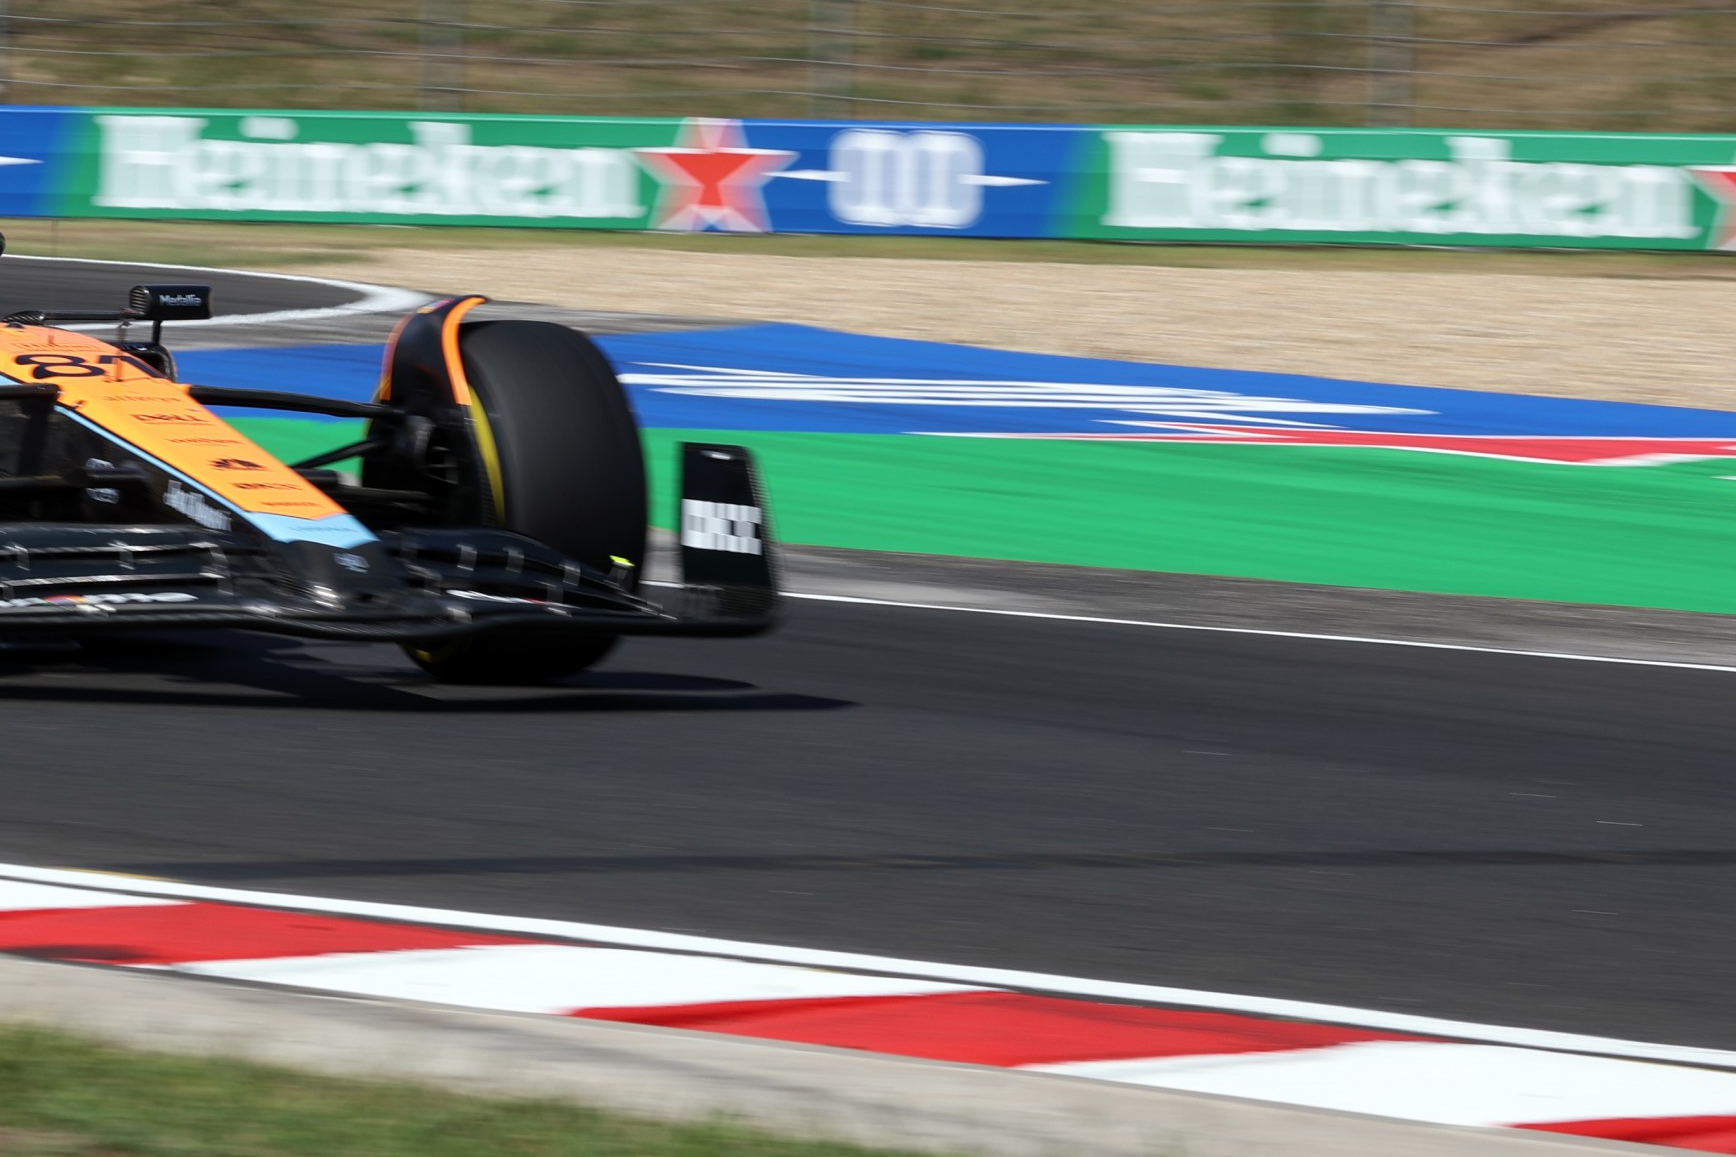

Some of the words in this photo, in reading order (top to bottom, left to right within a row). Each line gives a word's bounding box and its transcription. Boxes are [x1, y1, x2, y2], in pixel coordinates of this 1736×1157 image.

[91, 115, 647, 218] Heineken
[1100, 131, 1705, 240] Heineken
[159, 294, 202, 307] Medallia
[14, 354, 165, 379] 81
